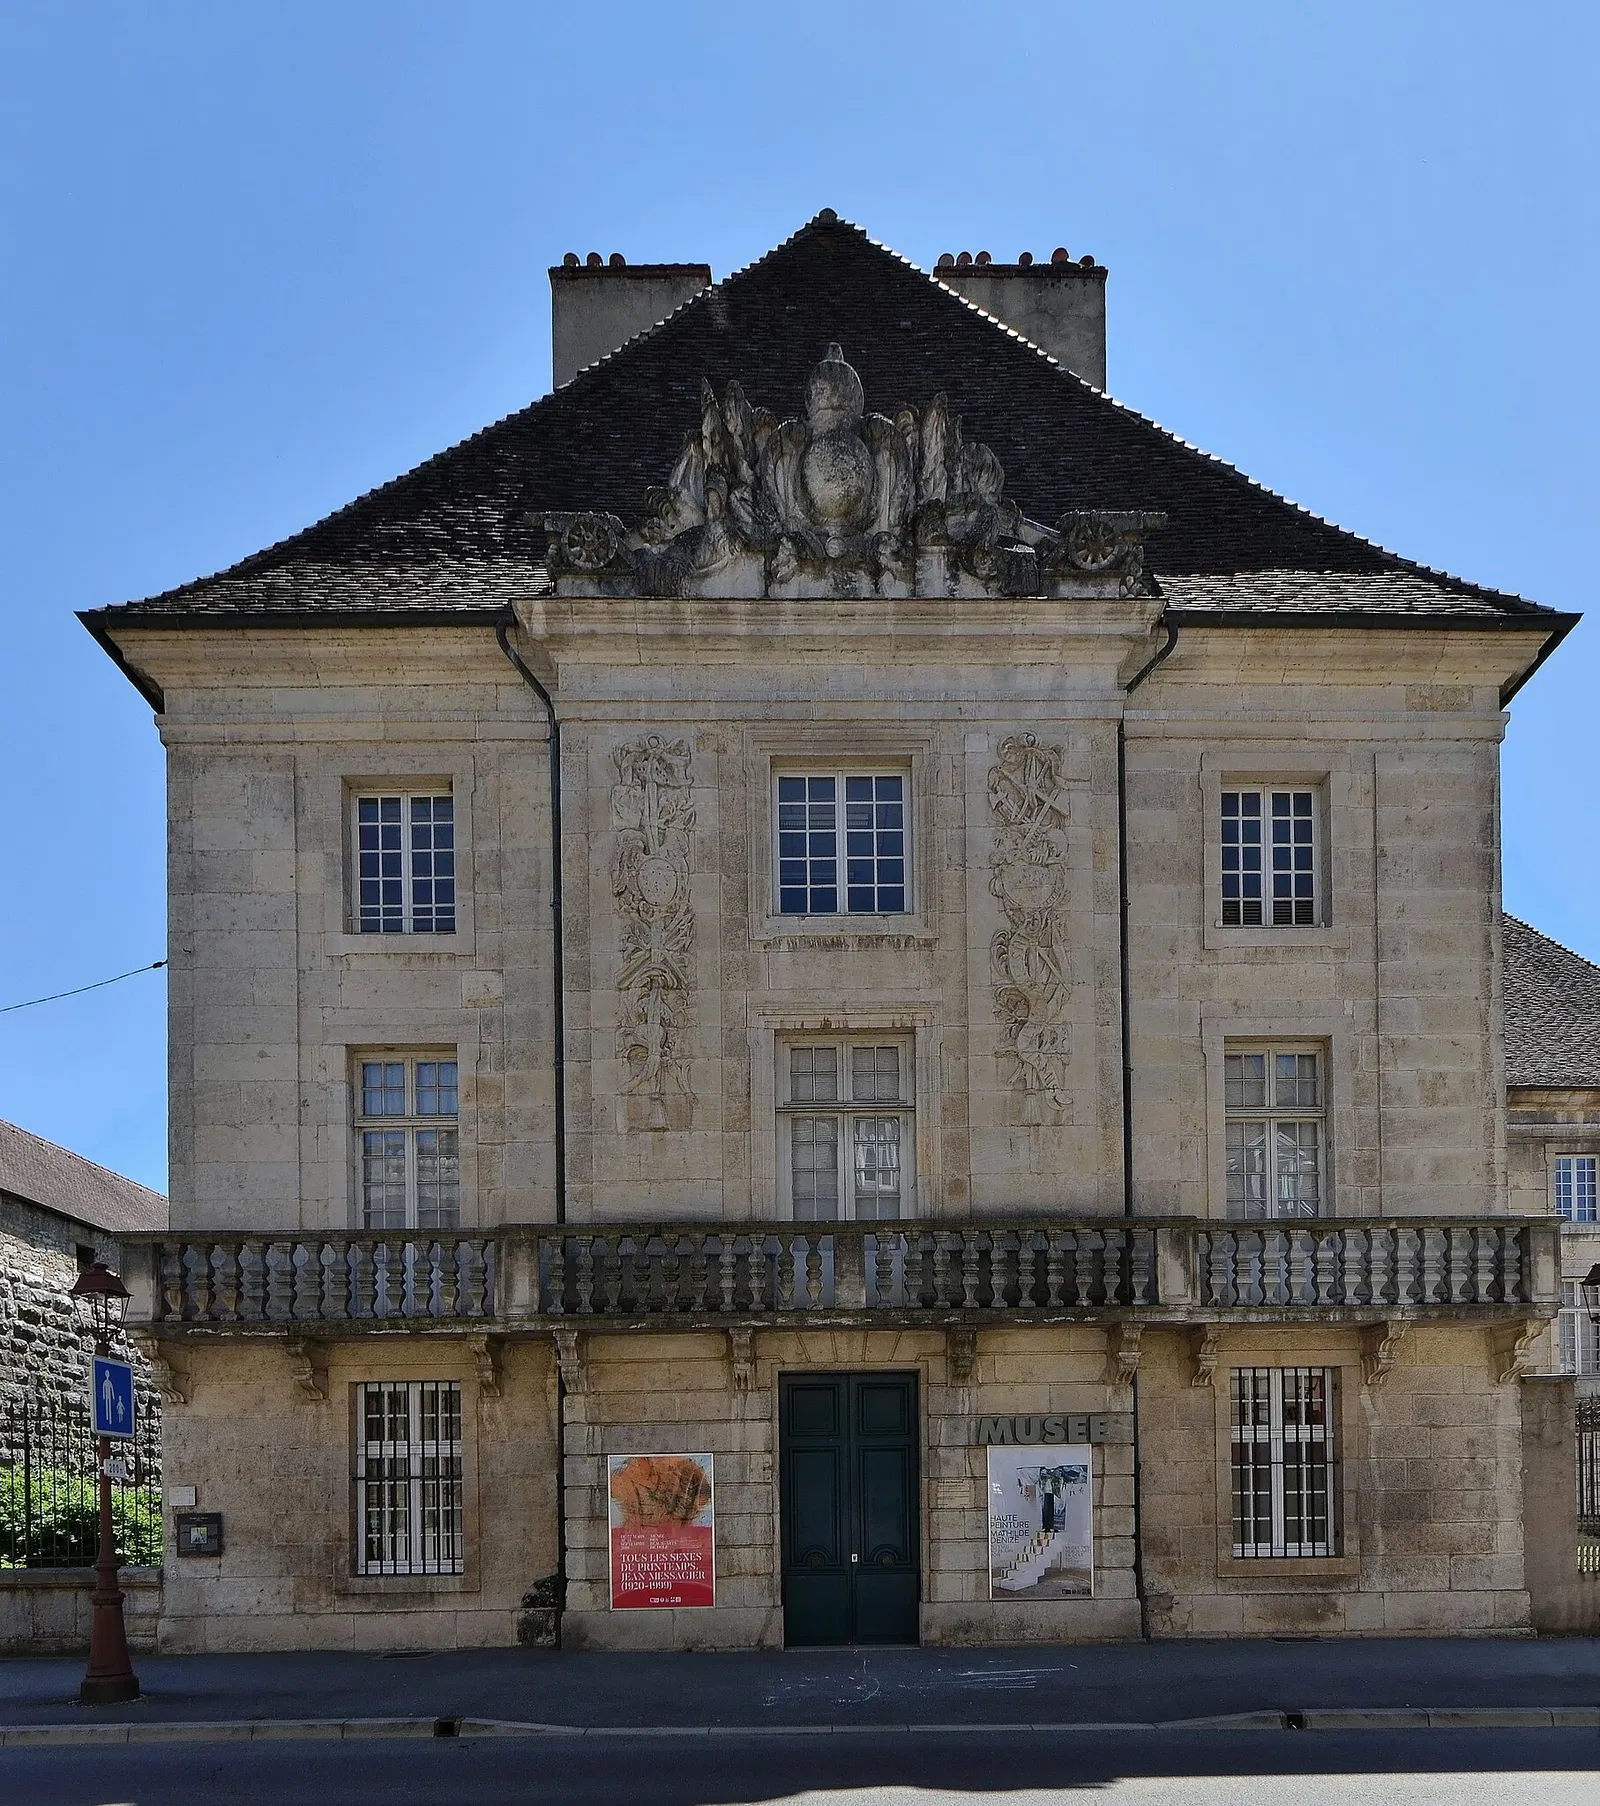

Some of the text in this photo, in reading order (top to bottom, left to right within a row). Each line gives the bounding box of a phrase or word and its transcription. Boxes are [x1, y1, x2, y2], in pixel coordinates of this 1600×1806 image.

[978, 1415, 1110, 1444] MUSEE
[990, 1514, 1018, 1522] HAUTE
[990, 1521, 1030, 1529] PEINTURE
[990, 1529, 1030, 1537] MATHILDE
[990, 1536, 1020, 1545] DENIZE
[620, 1552, 702, 1562] TOUS LES SEXES
[621, 1563, 635, 1572] DU
[621, 1571, 705, 1582] JEAN MESSAGIER
[621, 1581, 672, 1591] (1920-1999)
